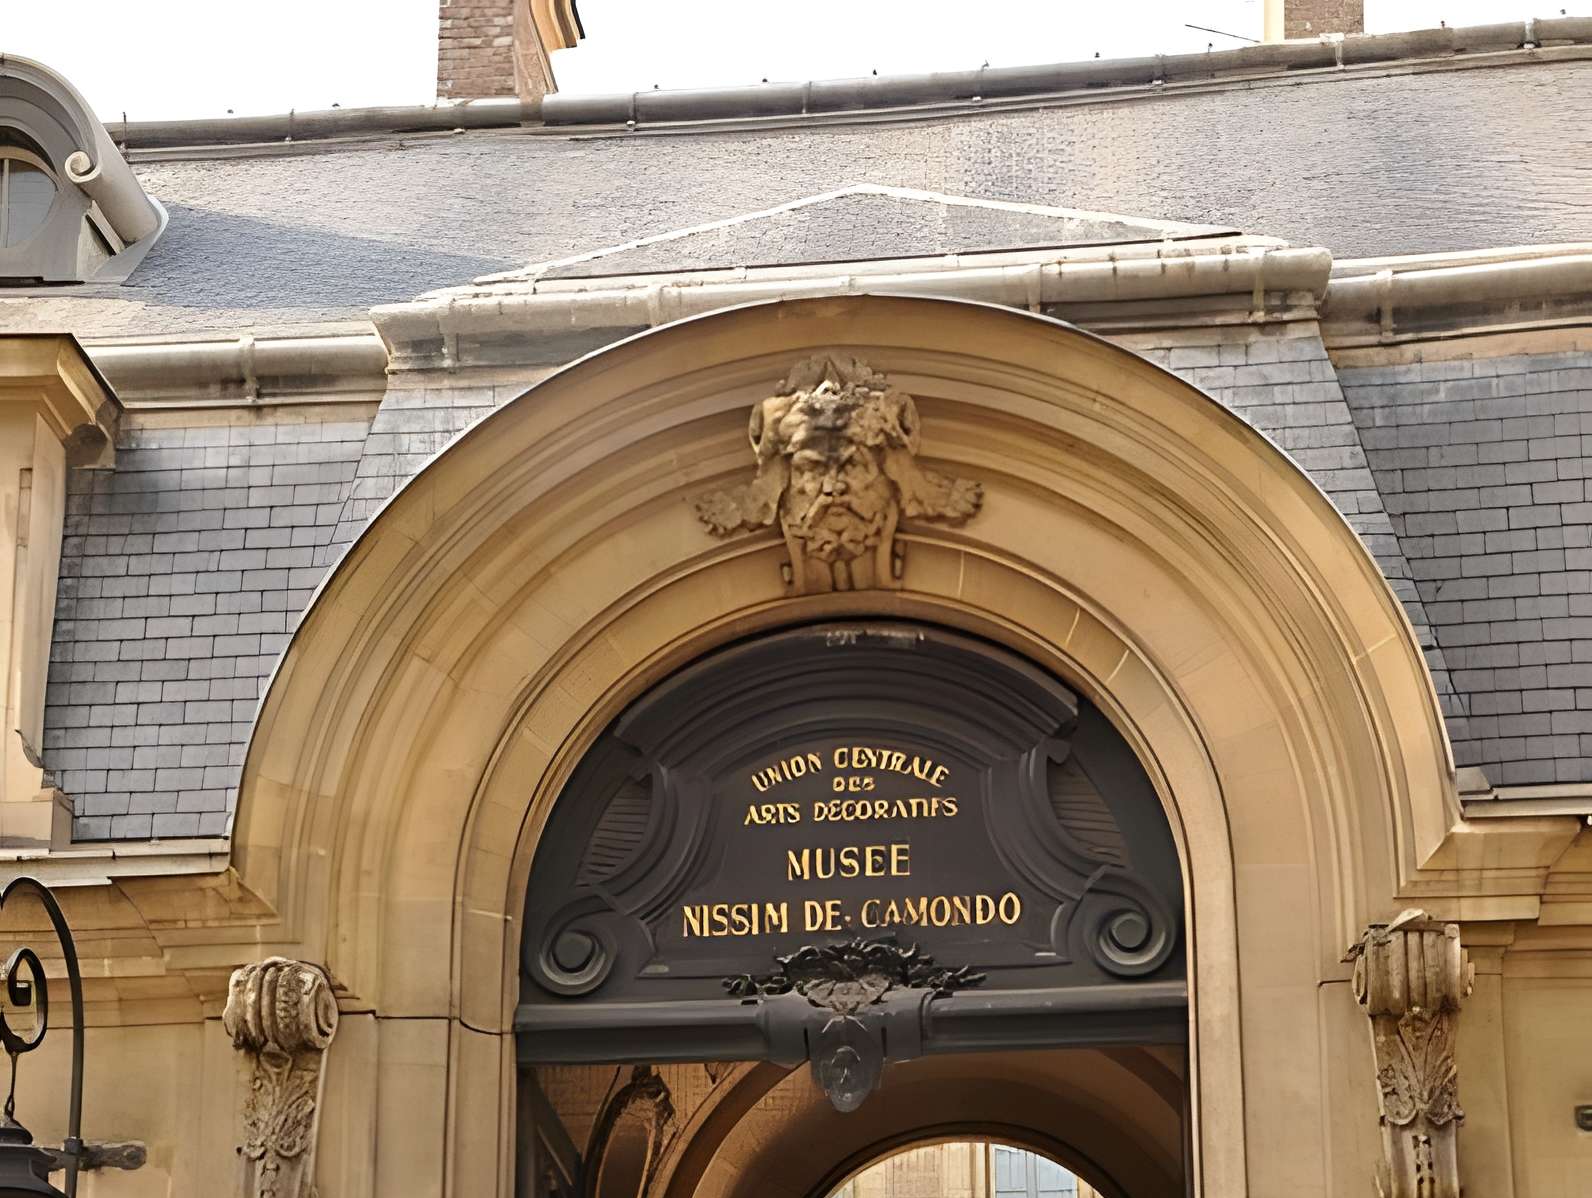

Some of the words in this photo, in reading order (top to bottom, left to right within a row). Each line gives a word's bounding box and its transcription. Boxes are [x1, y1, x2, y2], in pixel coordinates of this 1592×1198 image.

[751, 751, 822, 792] UNION
[744, 802, 801, 826] ARTS
[787, 843, 910, 881] MUSEE
[683, 901, 789, 937] NISSIM
[860, 891, 1021, 928] CAMONDO
